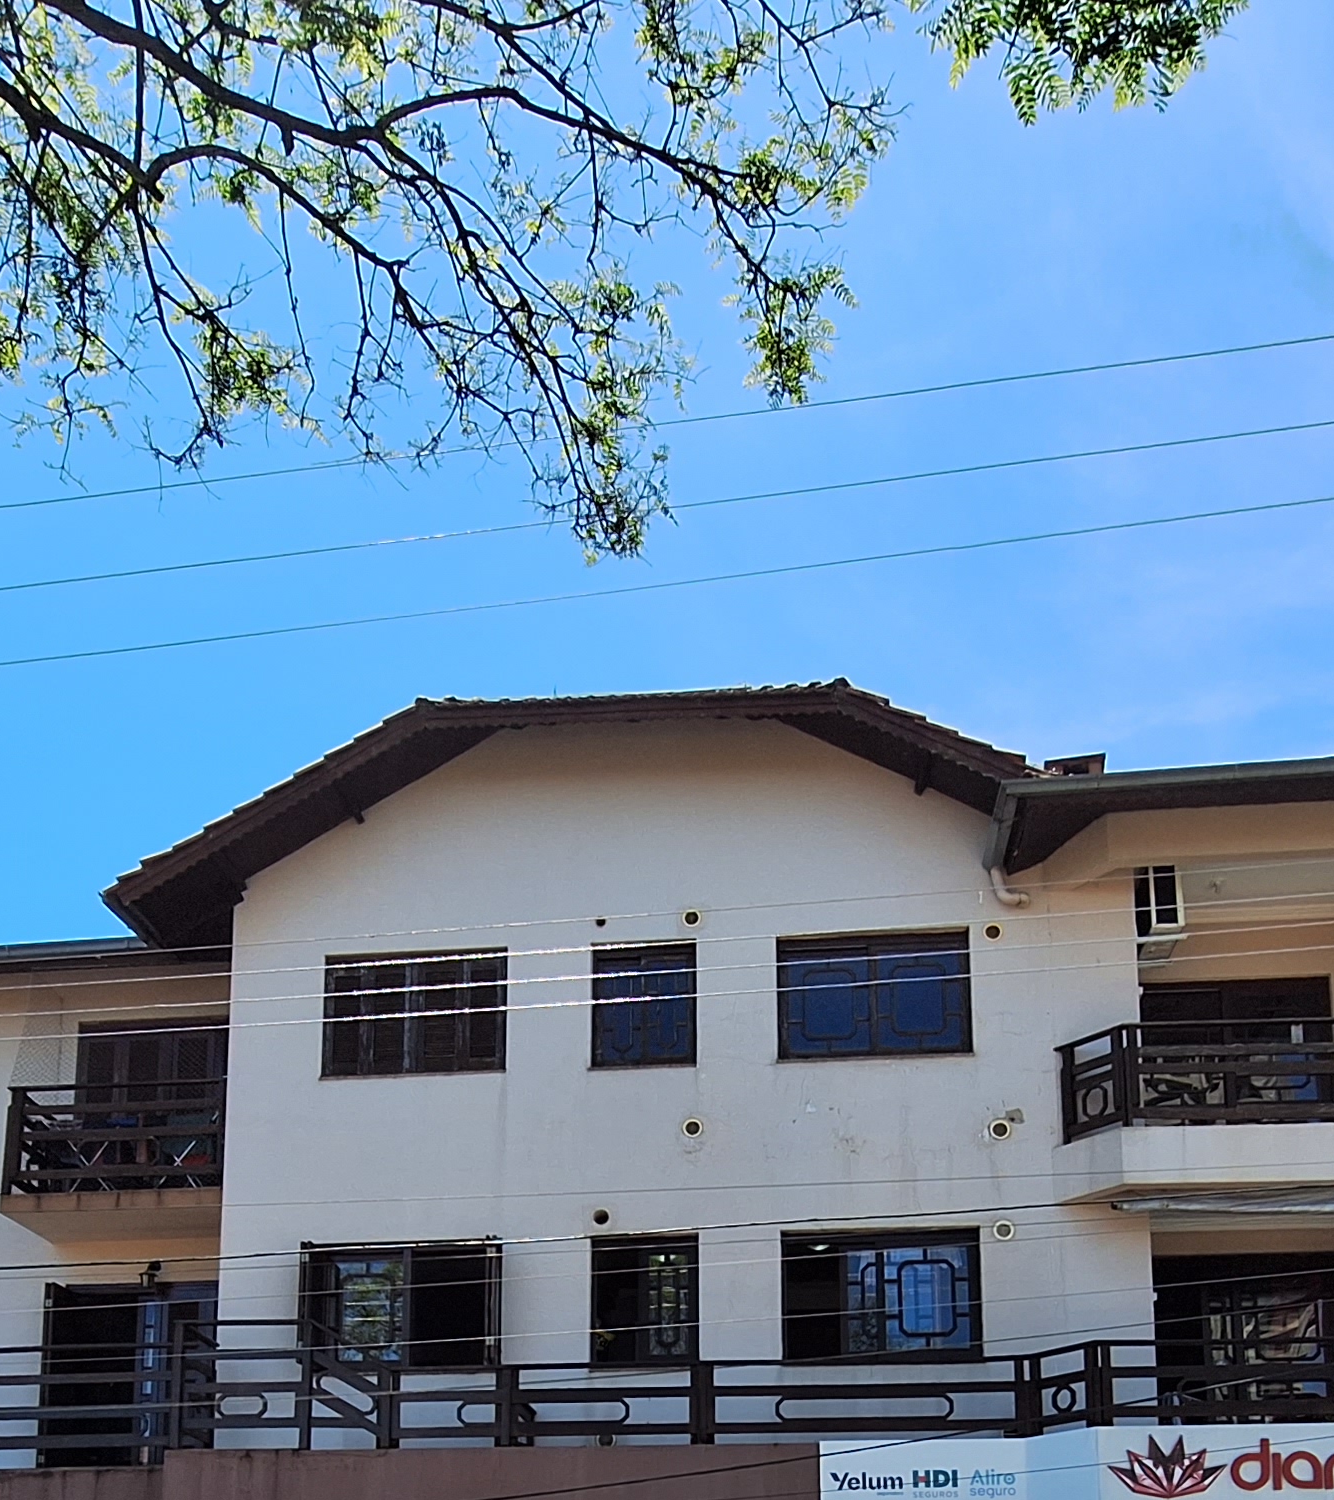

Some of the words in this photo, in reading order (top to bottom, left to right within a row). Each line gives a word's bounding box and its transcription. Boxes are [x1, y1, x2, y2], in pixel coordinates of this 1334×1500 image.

[830, 1471, 904, 1491] Yelum
[912, 1469, 959, 1488] HDI
[970, 1469, 1016, 1486] Aliro
[969, 1487, 1016, 1499] seguro
